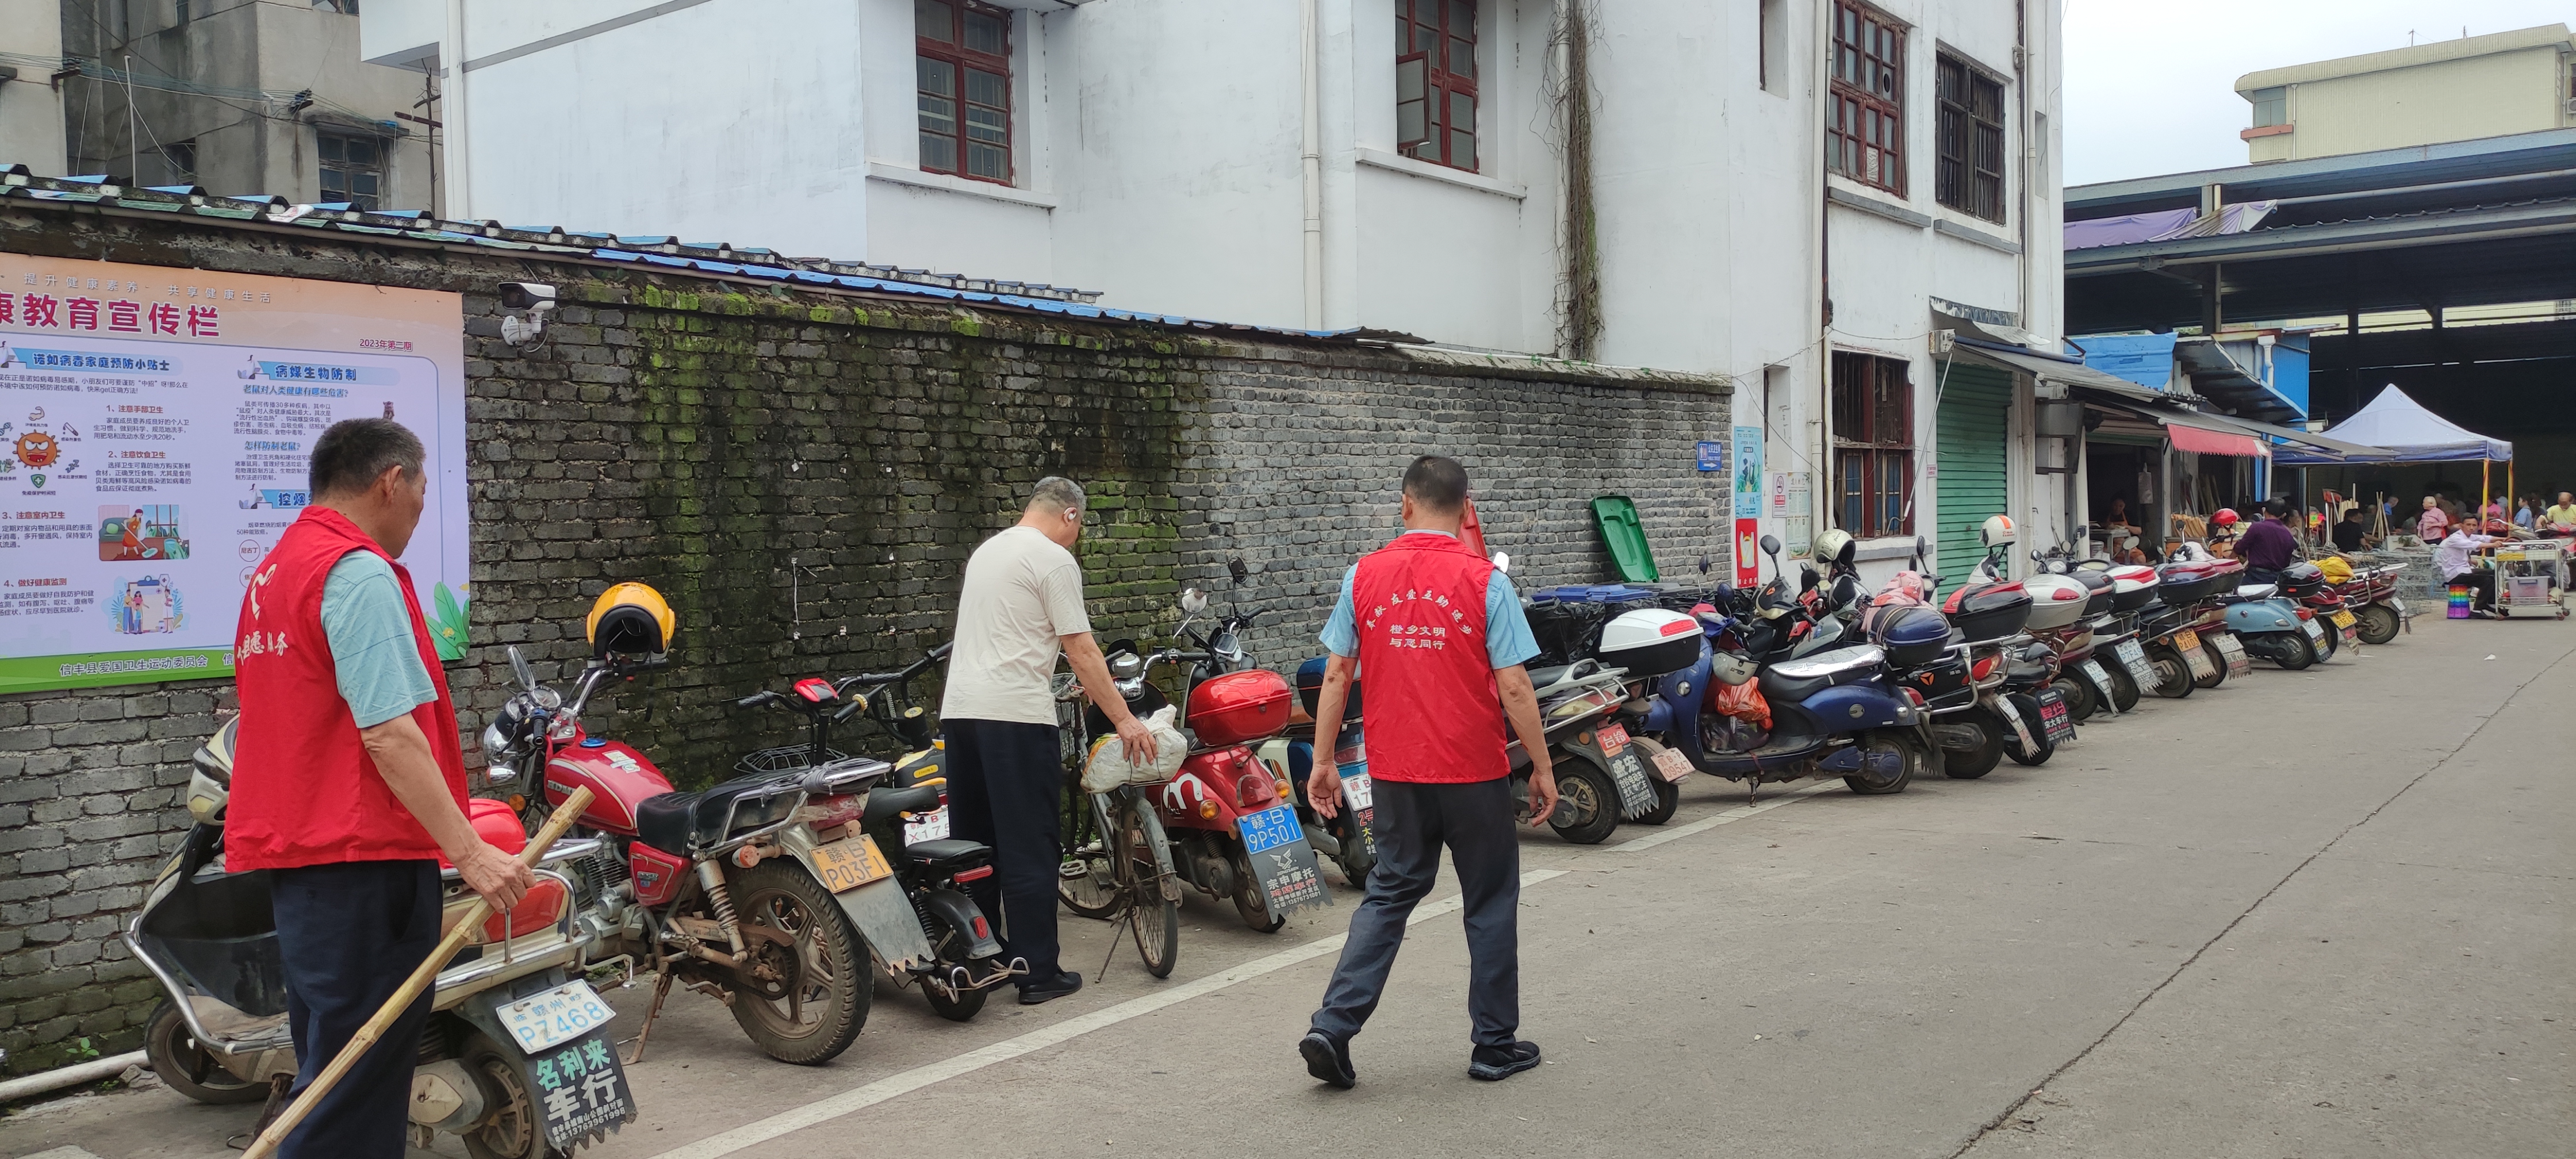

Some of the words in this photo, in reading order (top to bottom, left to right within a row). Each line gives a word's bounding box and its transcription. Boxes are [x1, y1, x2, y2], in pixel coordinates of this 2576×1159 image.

[167, 285, 271, 303] 共享健康生活
[359, 339, 412, 351] 2023年第二期
[33, 353, 170, 371] 诺如病毒家庭预防小贴士
[275, 364, 356, 382] 病媒生物防制
[106, 405, 164, 413] 1、注意手部卫生
[106, 417, 189, 425] 家庭成员要养成良好的个人卫
[108, 451, 166, 459] 2、注意饮食卫生
[278, 493, 311, 506] 控烟
[4, 578, 67, 587] 4、做好健康监测
[59, 654, 208, 677] 信丰县爱国卫生运动委员会
[1603, 731, 1626, 749] 台铃
[1664, 760, 1690, 778] 09547
[1248, 822, 1297, 850] 9P501
[1266, 867, 1315, 890] 宗申摩托
[536, 1039, 610, 1091] 名利来
[543, 1068, 618, 1121] 车行
